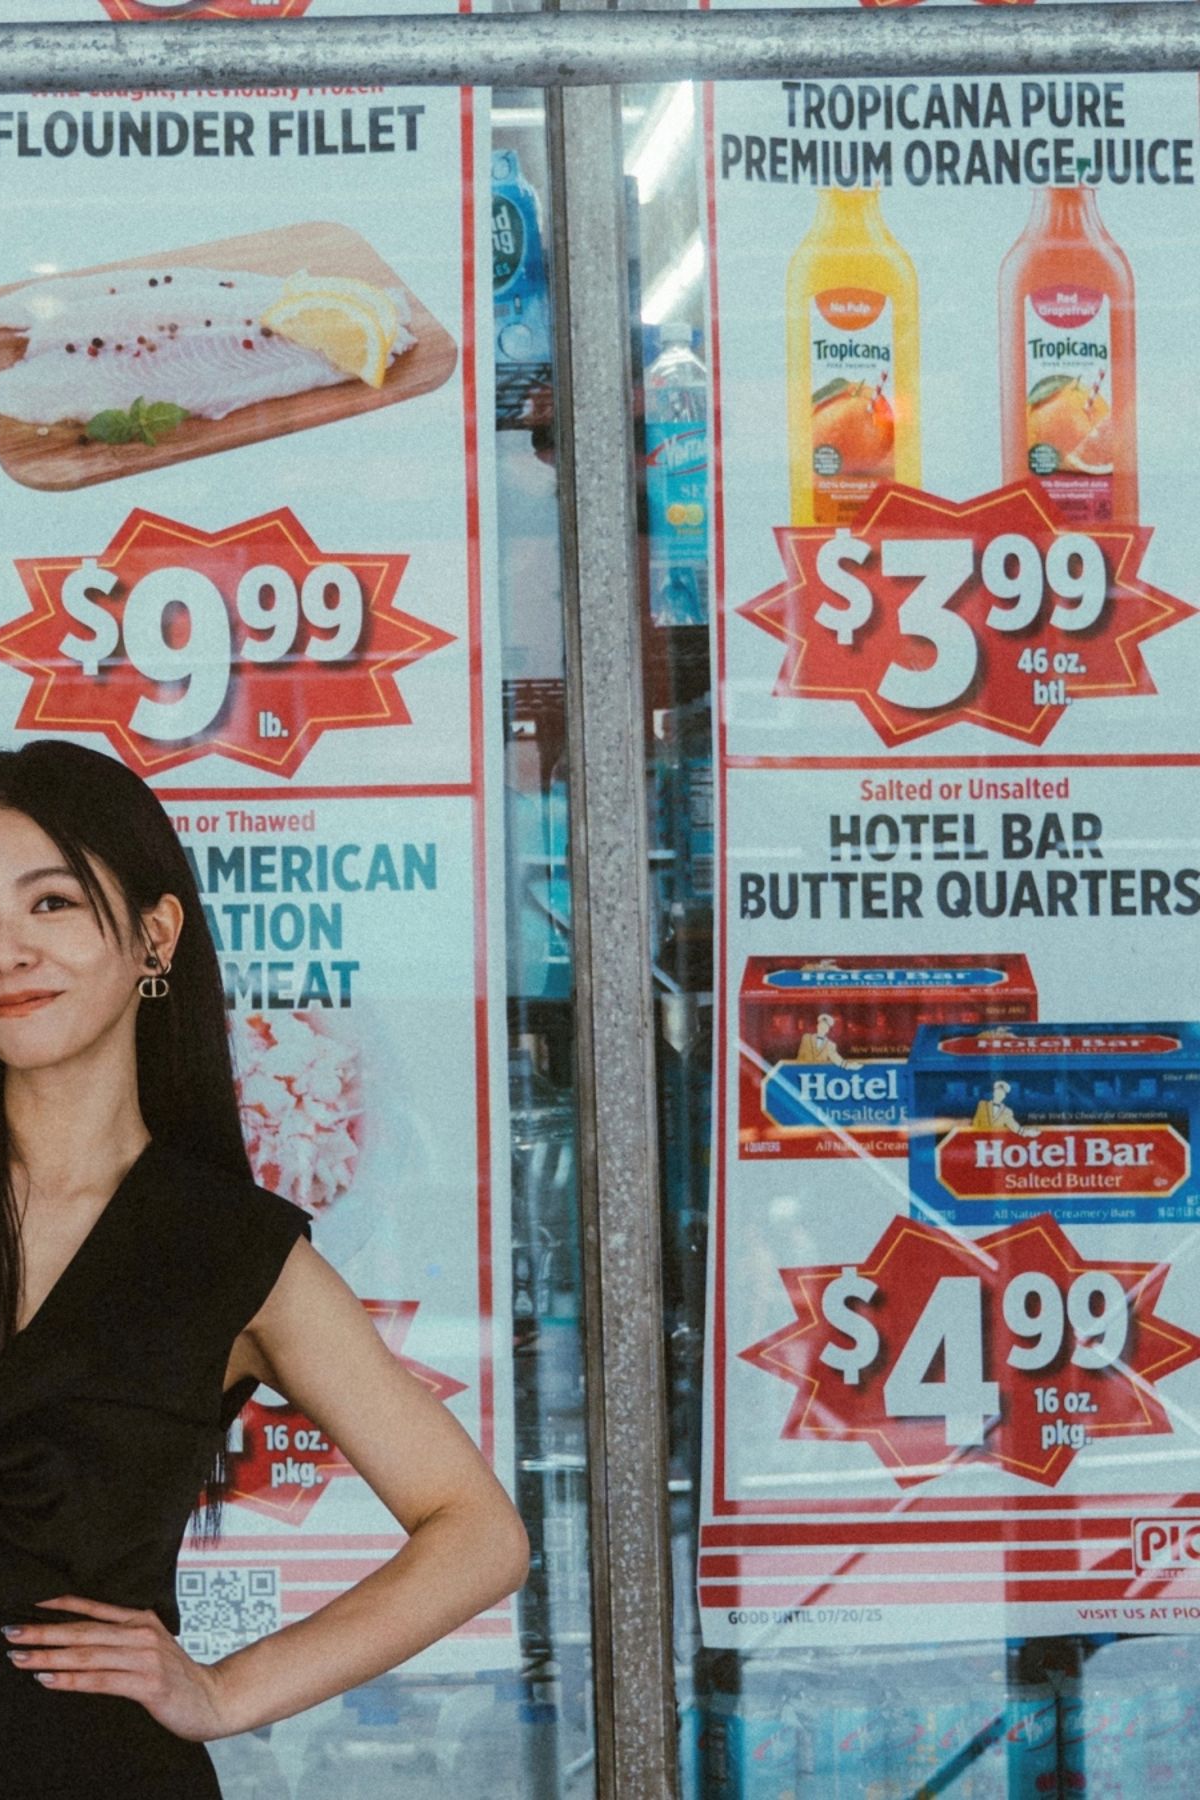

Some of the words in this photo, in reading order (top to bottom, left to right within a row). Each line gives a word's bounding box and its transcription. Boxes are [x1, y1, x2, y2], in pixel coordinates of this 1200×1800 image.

[782, 80, 1014, 130] TROPICANA
[1021, 80, 1126, 128] PURE
[268, 104, 426, 156] FILLET
[721, 134, 893, 187] PREMIUM
[903, 138, 1076, 187] ORANGE
[1085, 137, 1195, 185] JUICE
[812, 338, 891, 362] Tropicana
[1028, 337, 1108, 360] Tropicana
[1016, 648, 1048, 674] 46
[1052, 652, 1087, 674] oz.
[1032, 680, 1073, 706] btl.
[258, 711, 289, 738] lb.
[859, 779, 933, 801] Salted
[939, 784, 963, 799] or
[968, 777, 1070, 800] Unsalted
[196, 817, 220, 833] or
[226, 810, 316, 833] Thawed
[829, 813, 989, 862] HOTEL
[1001, 812, 1104, 860] BAR
[739, 871, 924, 920] BUTTER
[936, 868, 1200, 919] QUARTERS
[224, 960, 360, 1011] MEAT
[800, 969, 896, 982] Hotel
[902, 969, 972, 982] Bar
[977, 1038, 1071, 1048] Hotel
[1081, 1038, 1143, 1048] Bar
[798, 1069, 899, 1101] Hotel
[975, 1136, 1076, 1168] Hotel
[1084, 1138, 1154, 1167] Bar
[1004, 1171, 1063, 1189] Salted
[1066, 1171, 1123, 1188] Butter
[1054, 1209, 1109, 1220] Creamery
[1110, 1208, 1136, 1219] Bars
[1034, 1387, 1058, 1413] 16
[1063, 1391, 1098, 1413] oz.
[263, 1425, 289, 1451] 16
[294, 1428, 329, 1451] oz.
[1041, 1419, 1093, 1449] pkg.
[270, 1456, 323, 1488] pkg.
[728, 1611, 769, 1625] GOOD
[771, 1610, 814, 1624] UNTIL
[816, 1608, 883, 1625] 07/20/25
[1077, 1608, 1118, 1620] VISIT
[1123, 1608, 1145, 1619] US
[1149, 1607, 1168, 1619] AT
